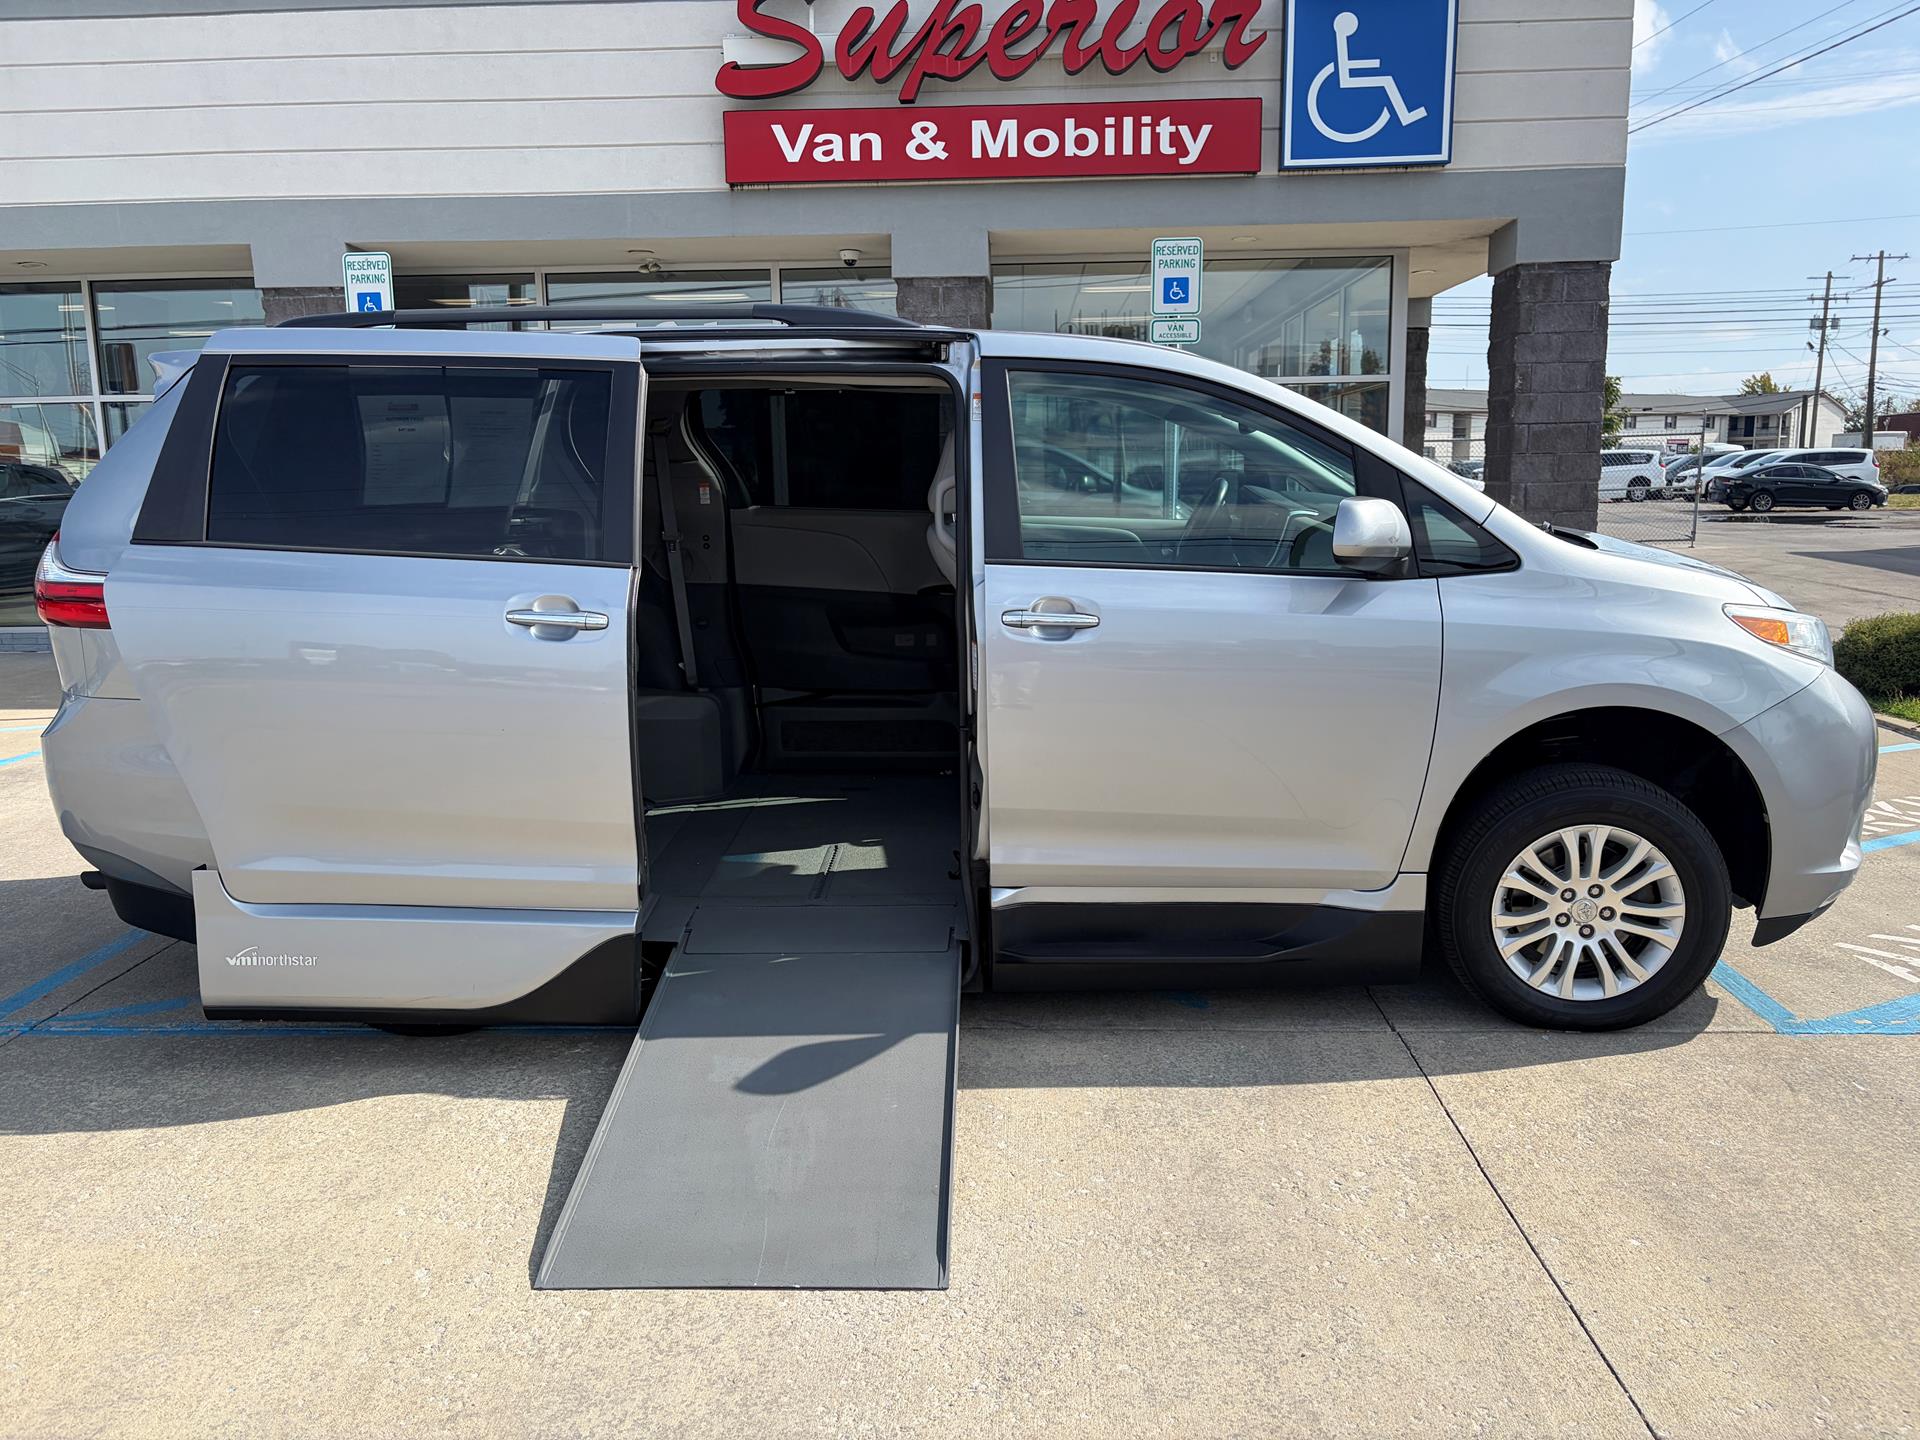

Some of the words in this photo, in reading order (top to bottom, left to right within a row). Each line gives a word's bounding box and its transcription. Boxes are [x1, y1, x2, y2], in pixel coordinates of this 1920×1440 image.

[715, 0, 1267, 104] Superior
[771, 123, 882, 163] Van
[905, 121, 949, 160] &
[971, 115, 1213, 164] Mobility
[1155, 245, 1199, 256] RESERVED
[346, 260, 387, 271] RESERVED
[1158, 258, 1196, 269] PARKING
[350, 273, 386, 284] PARKING
[1167, 323, 1185, 331] VAN
